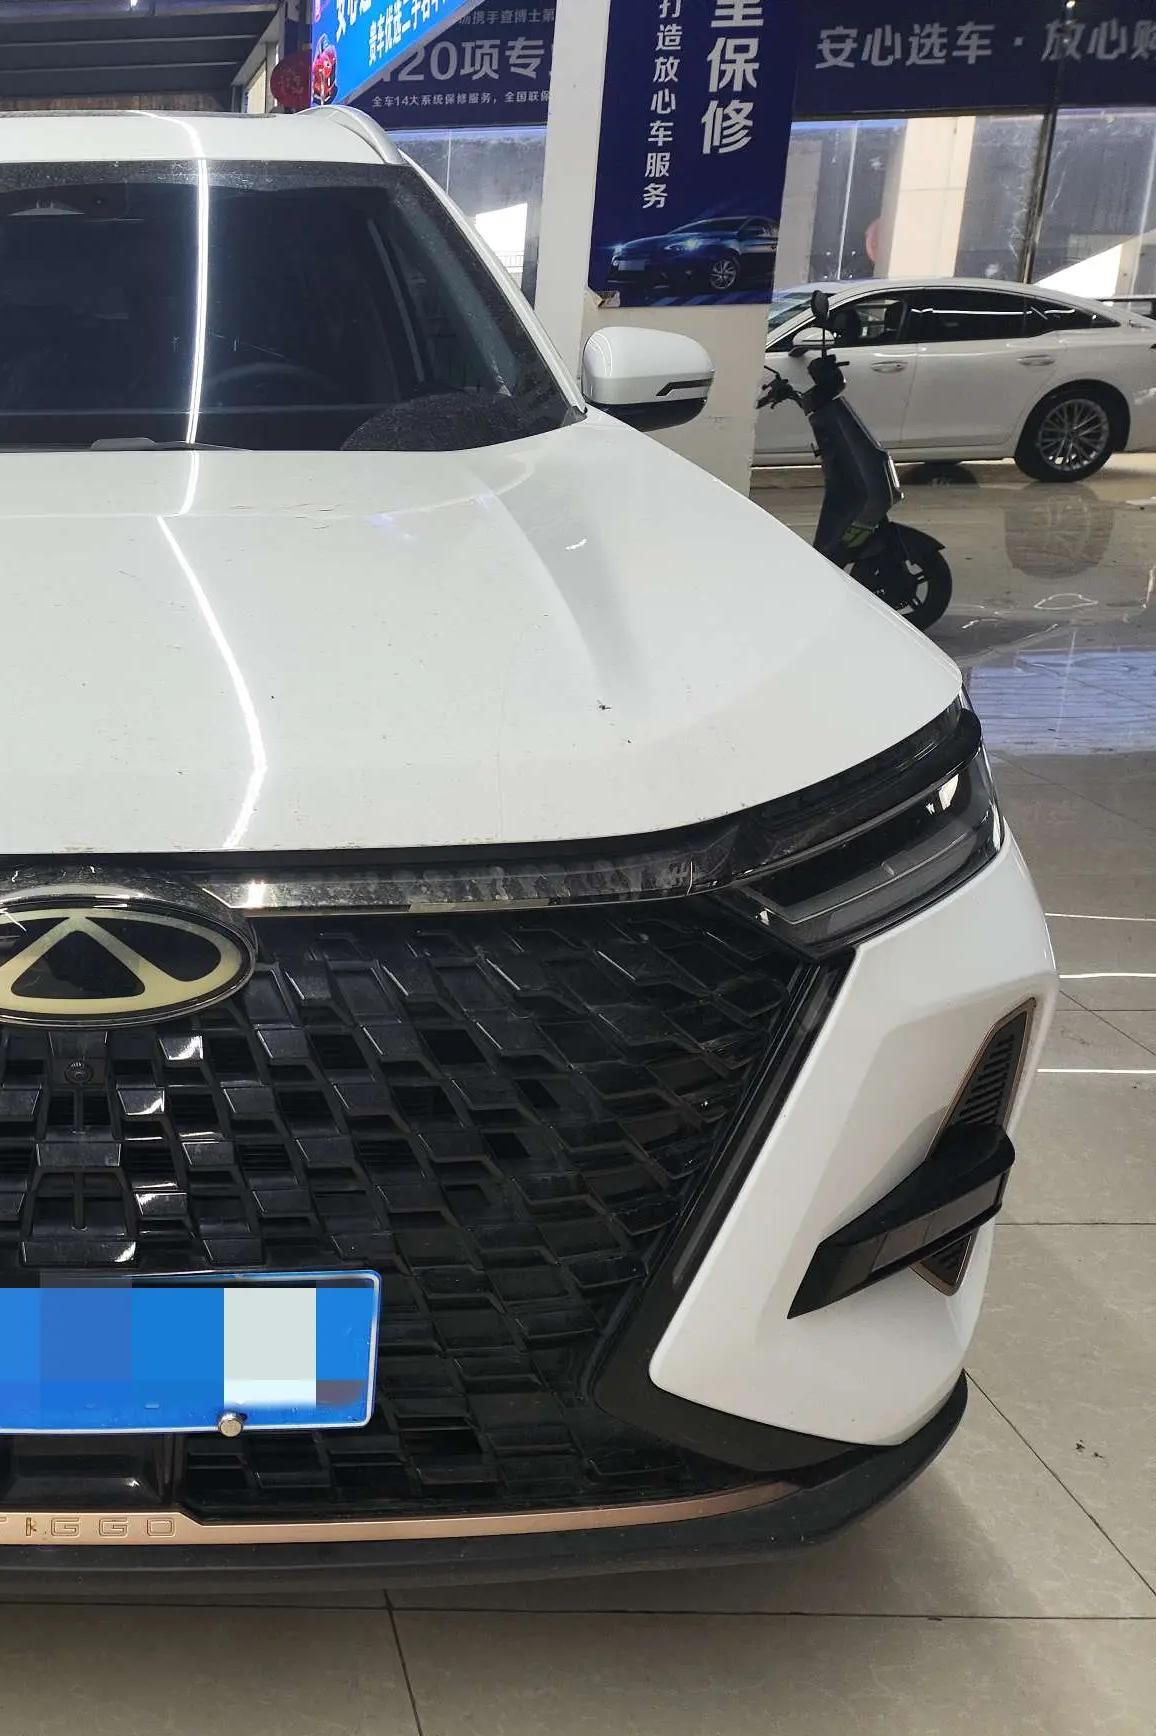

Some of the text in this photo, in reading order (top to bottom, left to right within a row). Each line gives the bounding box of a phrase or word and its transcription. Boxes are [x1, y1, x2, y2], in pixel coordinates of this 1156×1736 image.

[642, 0, 683, 208] 打造放心车服务
